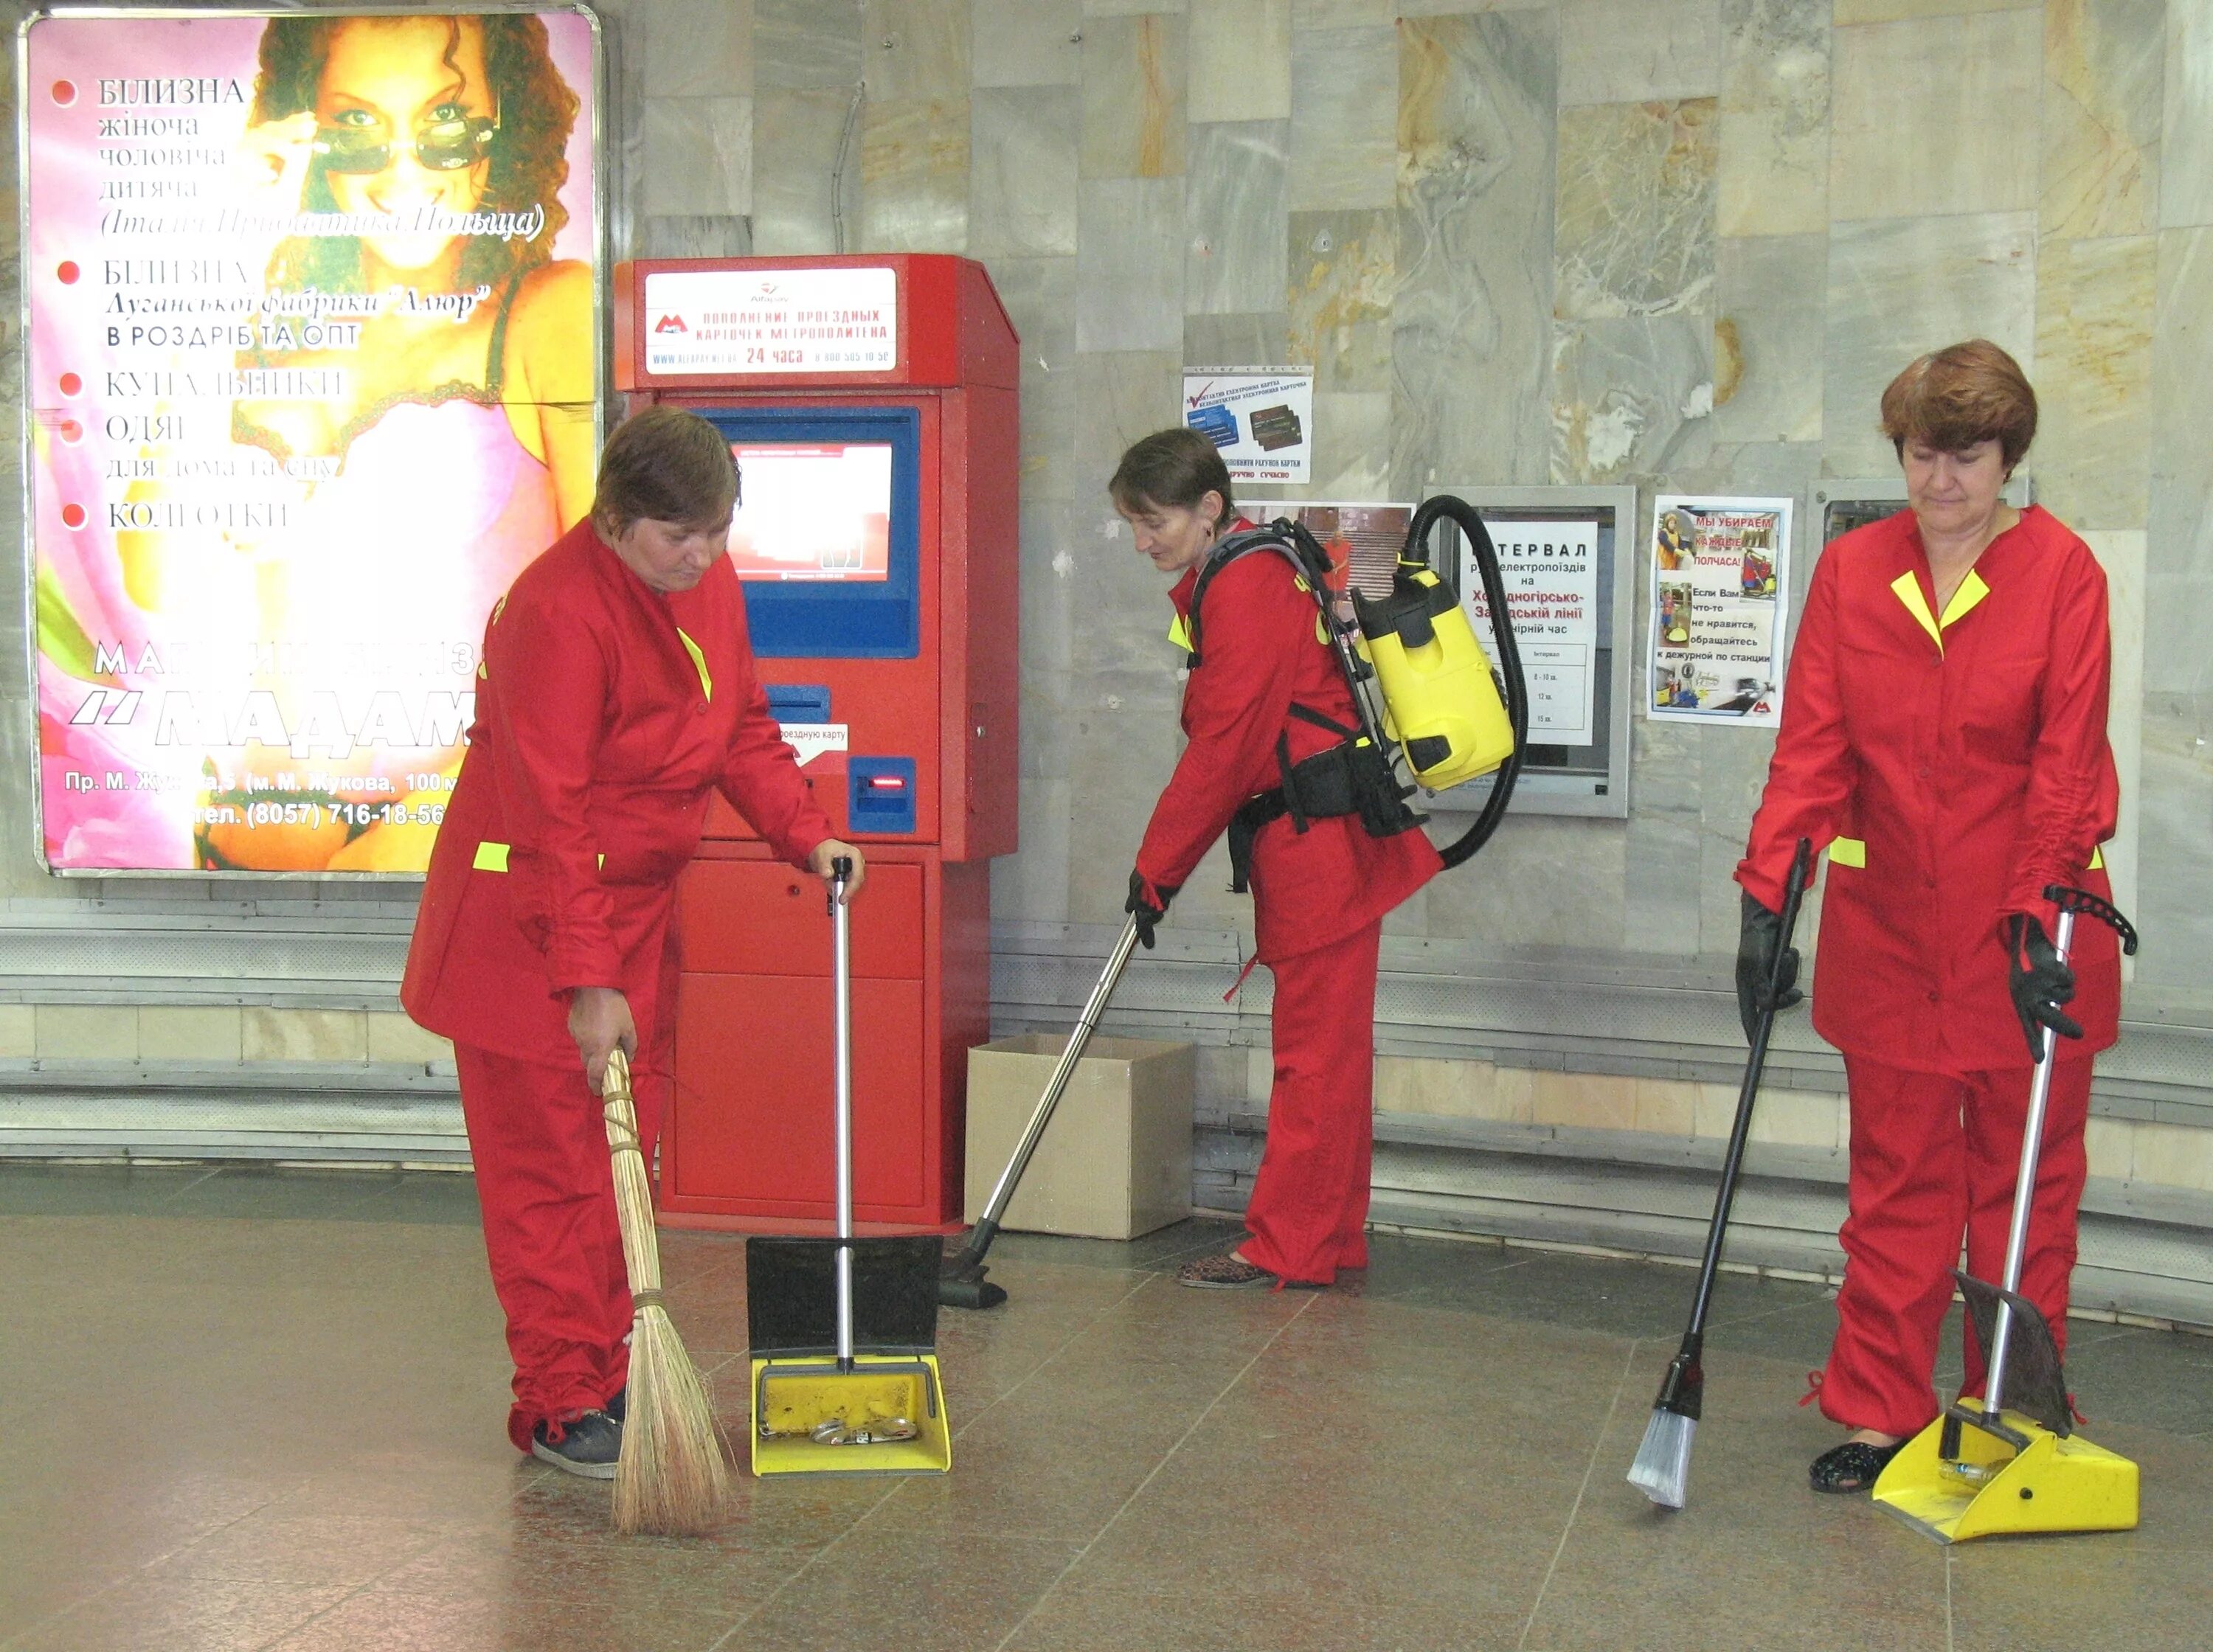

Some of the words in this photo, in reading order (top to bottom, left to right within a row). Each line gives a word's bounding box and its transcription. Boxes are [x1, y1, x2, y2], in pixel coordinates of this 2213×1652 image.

[98, 78, 244, 105] БІЛИЗНА
[99, 111, 198, 136] жіноча
[100, 142, 225, 166] чоловіча
[98, 181, 198, 201] дитяча
[261, 288, 377, 319] фабрики
[108, 326, 120, 346] В
[132, 326, 250, 349] РОЗДРІБ
[262, 326, 291, 345] ТА
[304, 325, 357, 345] ОПТ
[747, 348, 764, 363] 24
[773, 350, 803, 363] часа
[106, 459, 154, 478] для
[1697, 516, 1714, 527] МЫ
[1472, 544, 1586, 556] ТЕРВАЛ
[1500, 562, 1586, 573] електропоїздів
[1694, 557, 1740, 566] ПОЛЧАСА!
[1693, 588, 1716, 597] Если
[1720, 589, 1739, 597] Вам
[1475, 605, 1549, 620] Задській
[1554, 607, 1583, 618] лінії
[1548, 625, 1568, 634] час
[1707, 621, 1756, 631] нравится,
[1691, 635, 1757, 646] обращайтесь
[1666, 651, 1713, 662] дежурной
[1731, 654, 1770, 663] станции
[780, 730, 820, 740] роездную
[822, 730, 845, 741] карту
[65, 771, 100, 794] Пр.
[105, 771, 129, 791] М.
[195, 806, 242, 825] тел.
[246, 802, 321, 830] (8057)
[328, 803, 446, 825] 716-18-56
